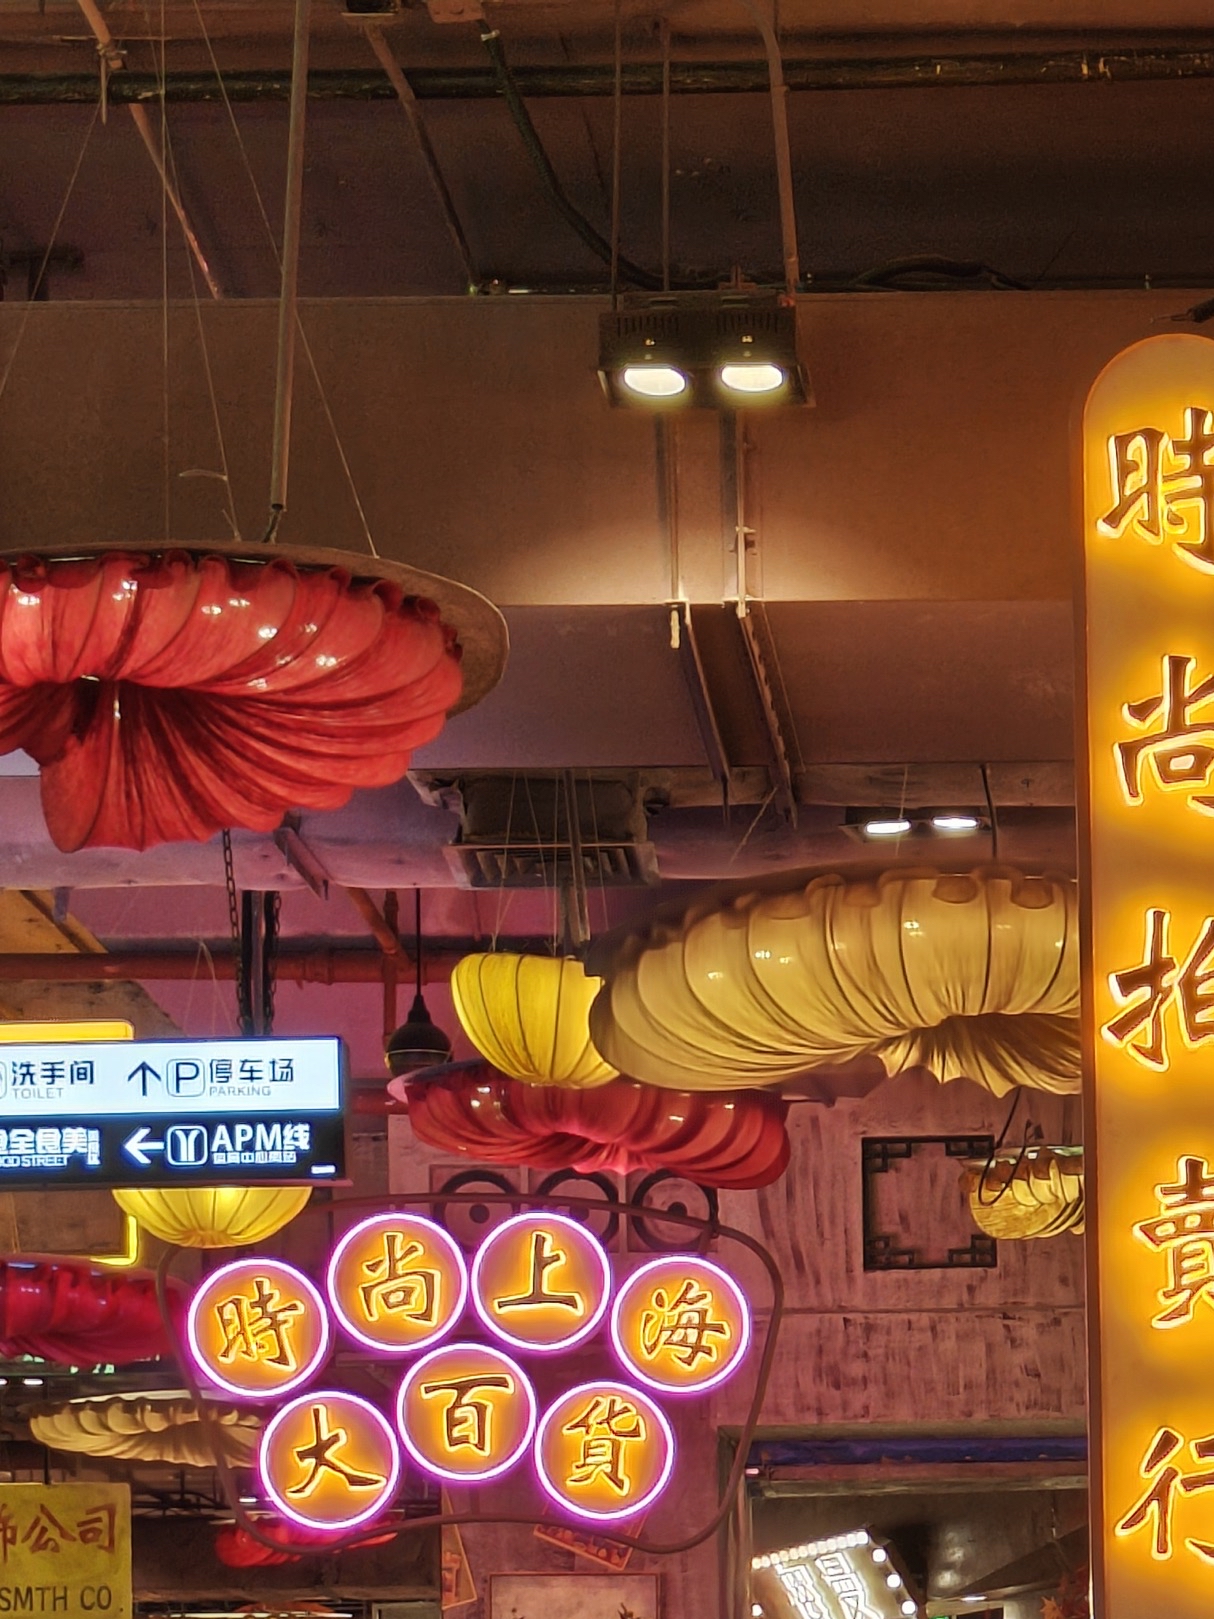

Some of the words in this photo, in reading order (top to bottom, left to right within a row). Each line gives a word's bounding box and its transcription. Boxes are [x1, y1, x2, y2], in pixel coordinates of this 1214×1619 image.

[12, 1061, 94, 1086] 洗手间
[210, 1059, 294, 1083] 停车场
[13, 1088, 64, 1099] TOILET
[210, 1085, 271, 1096] PARKING
[212, 1123, 310, 1151] APM线
[214, 1230, 731, 1371] 時尚上海
[285, 1373, 647, 1499] 大百貨
